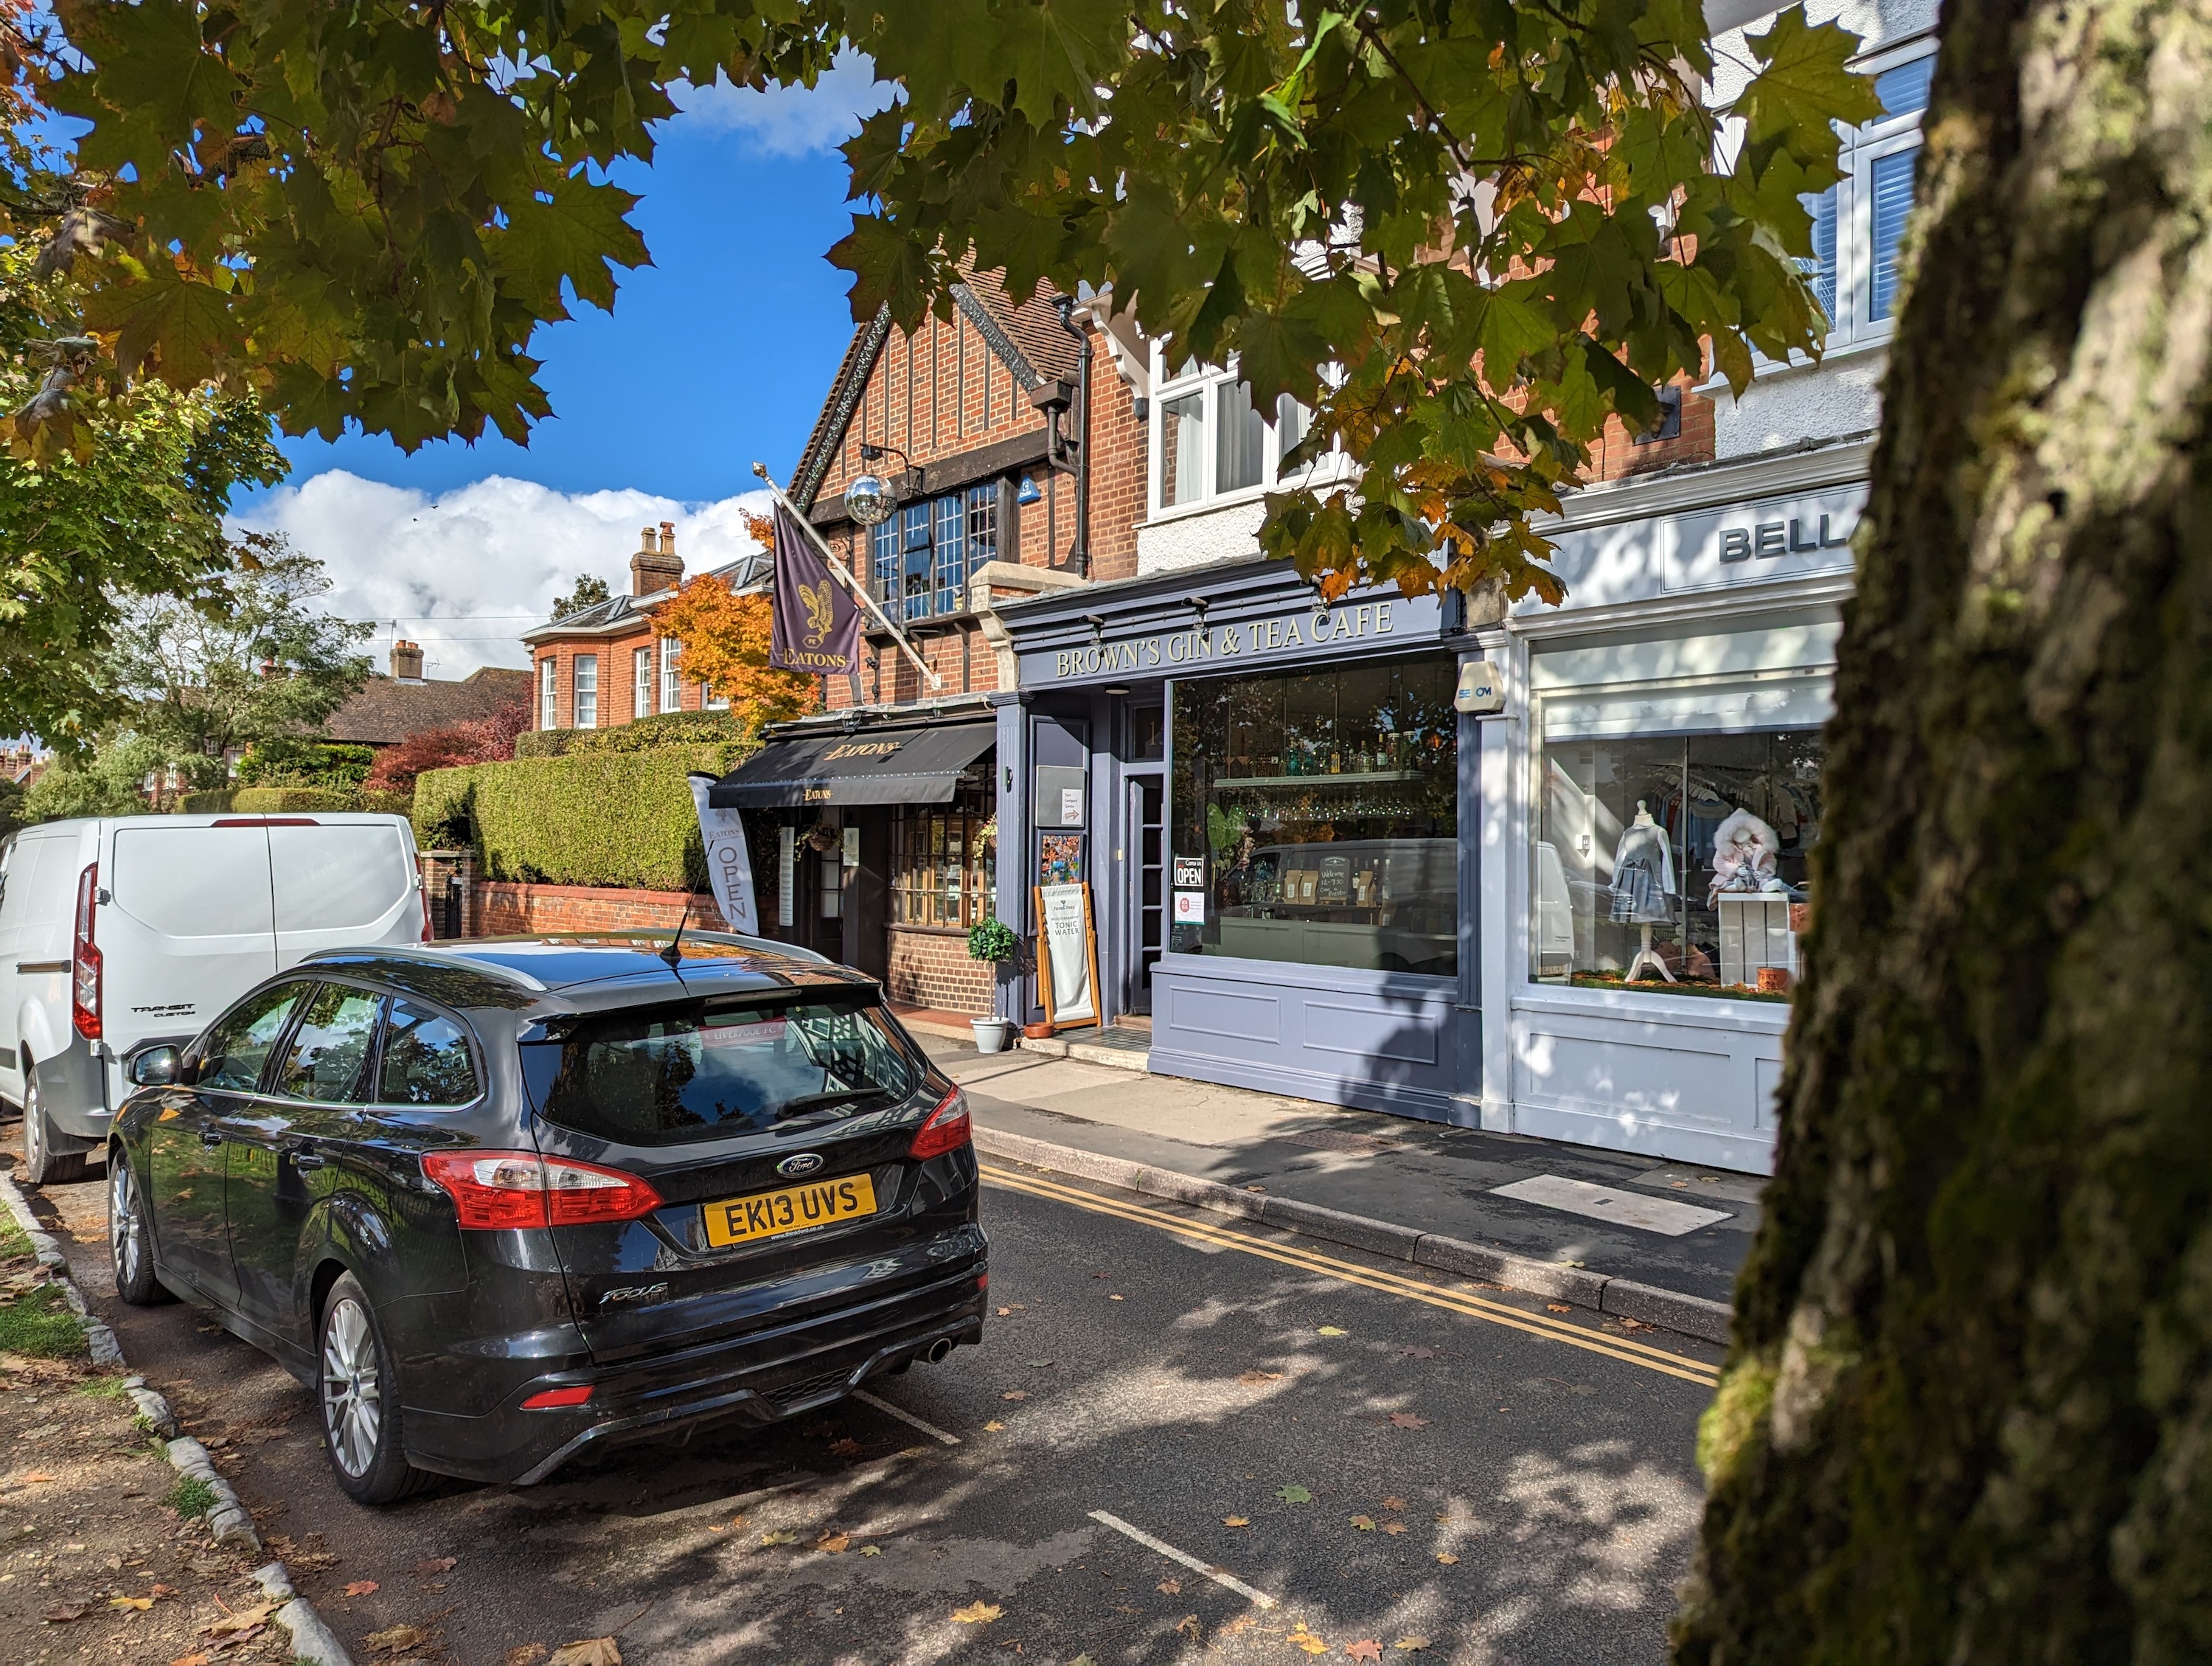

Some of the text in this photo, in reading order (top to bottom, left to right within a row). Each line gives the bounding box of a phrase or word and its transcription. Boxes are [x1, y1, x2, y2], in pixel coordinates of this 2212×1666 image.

[1719, 514, 1861, 565] BELL
[1167, 630, 1214, 662] GIN
[1220, 626, 1241, 655] &
[1248, 617, 1304, 651] TEA
[1310, 602, 1394, 642] CAFE
[783, 648, 846, 668] EATONS
[1458, 687, 1492, 699] SEOM
[823, 741, 900, 761] EATONS
[805, 788, 832, 801] EATONS
[718, 847, 747, 920] OPEN
[1177, 867, 1202, 884] OPEN
[1054, 920, 1077, 929] TONIC
[1054, 928, 1079, 936] WATER
[714, 1024, 776, 1040] LIVERPOOL FC
[788, 1157, 815, 1173] Ford
[725, 1182, 858, 1237] EK13 UVS
[771, 1224, 825, 1240] www.thinkford.co.uk
